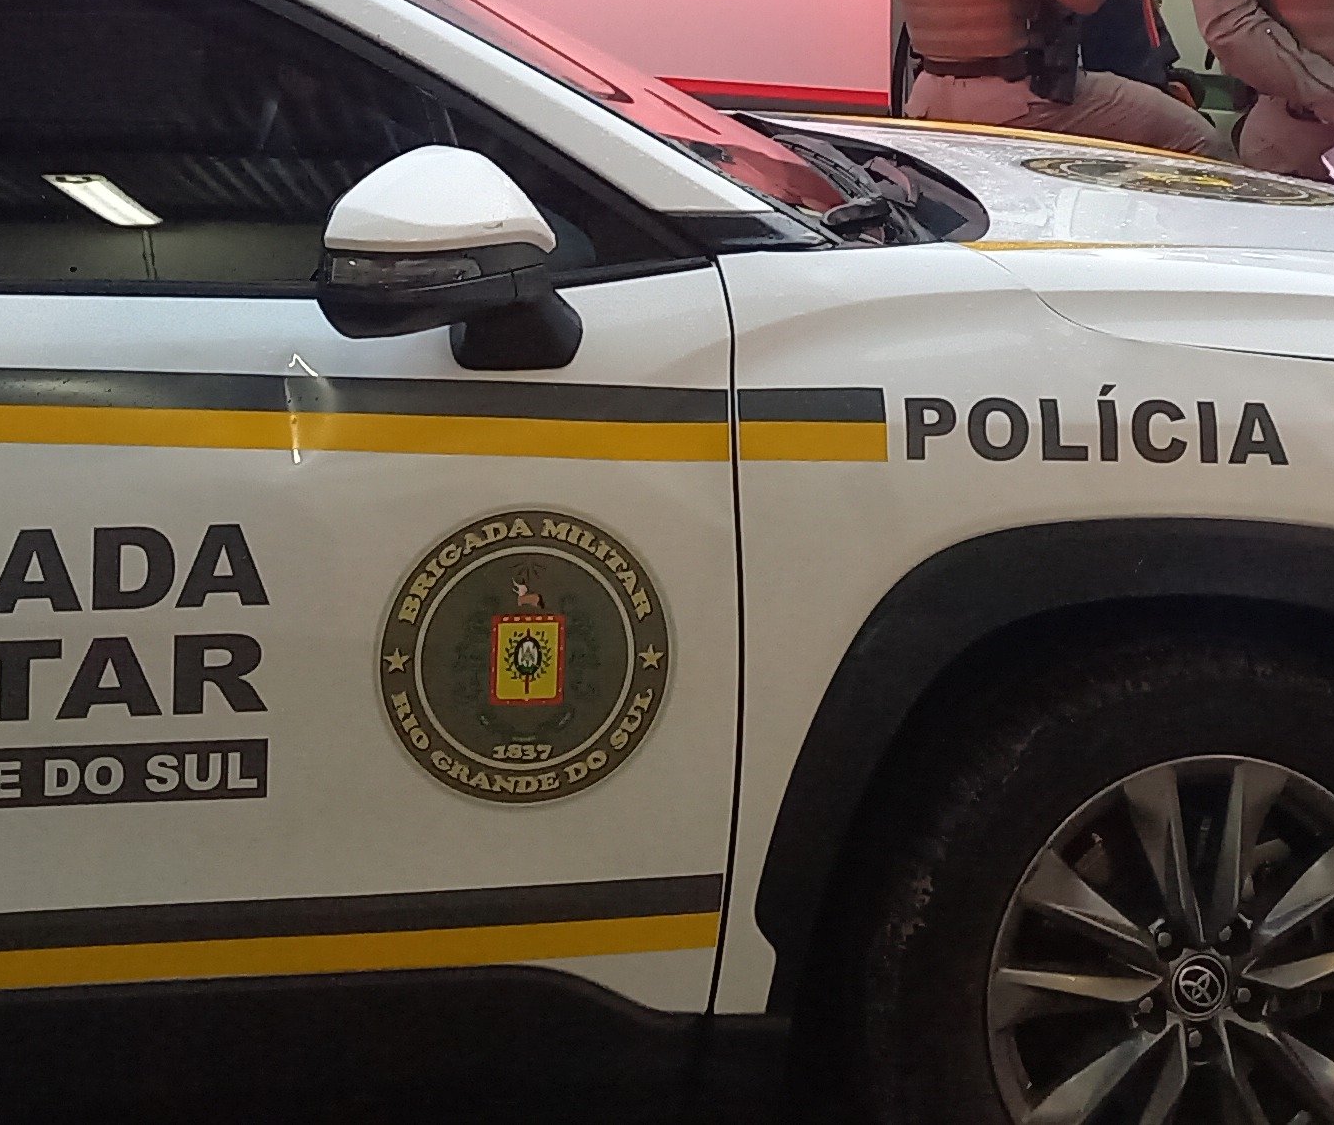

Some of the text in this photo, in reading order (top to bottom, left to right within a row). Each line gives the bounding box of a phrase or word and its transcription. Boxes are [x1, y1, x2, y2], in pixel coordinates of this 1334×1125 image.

[903, 384, 1289, 466] POLÍCIA
[398, 518, 653, 625] BRIGADA MILITAR
[42, 756, 125, 797] DO
[144, 750, 259, 793] SUL
[390, 687, 654, 794] RIO GRANDE DO SUL
[491, 743, 554, 760] 1837
